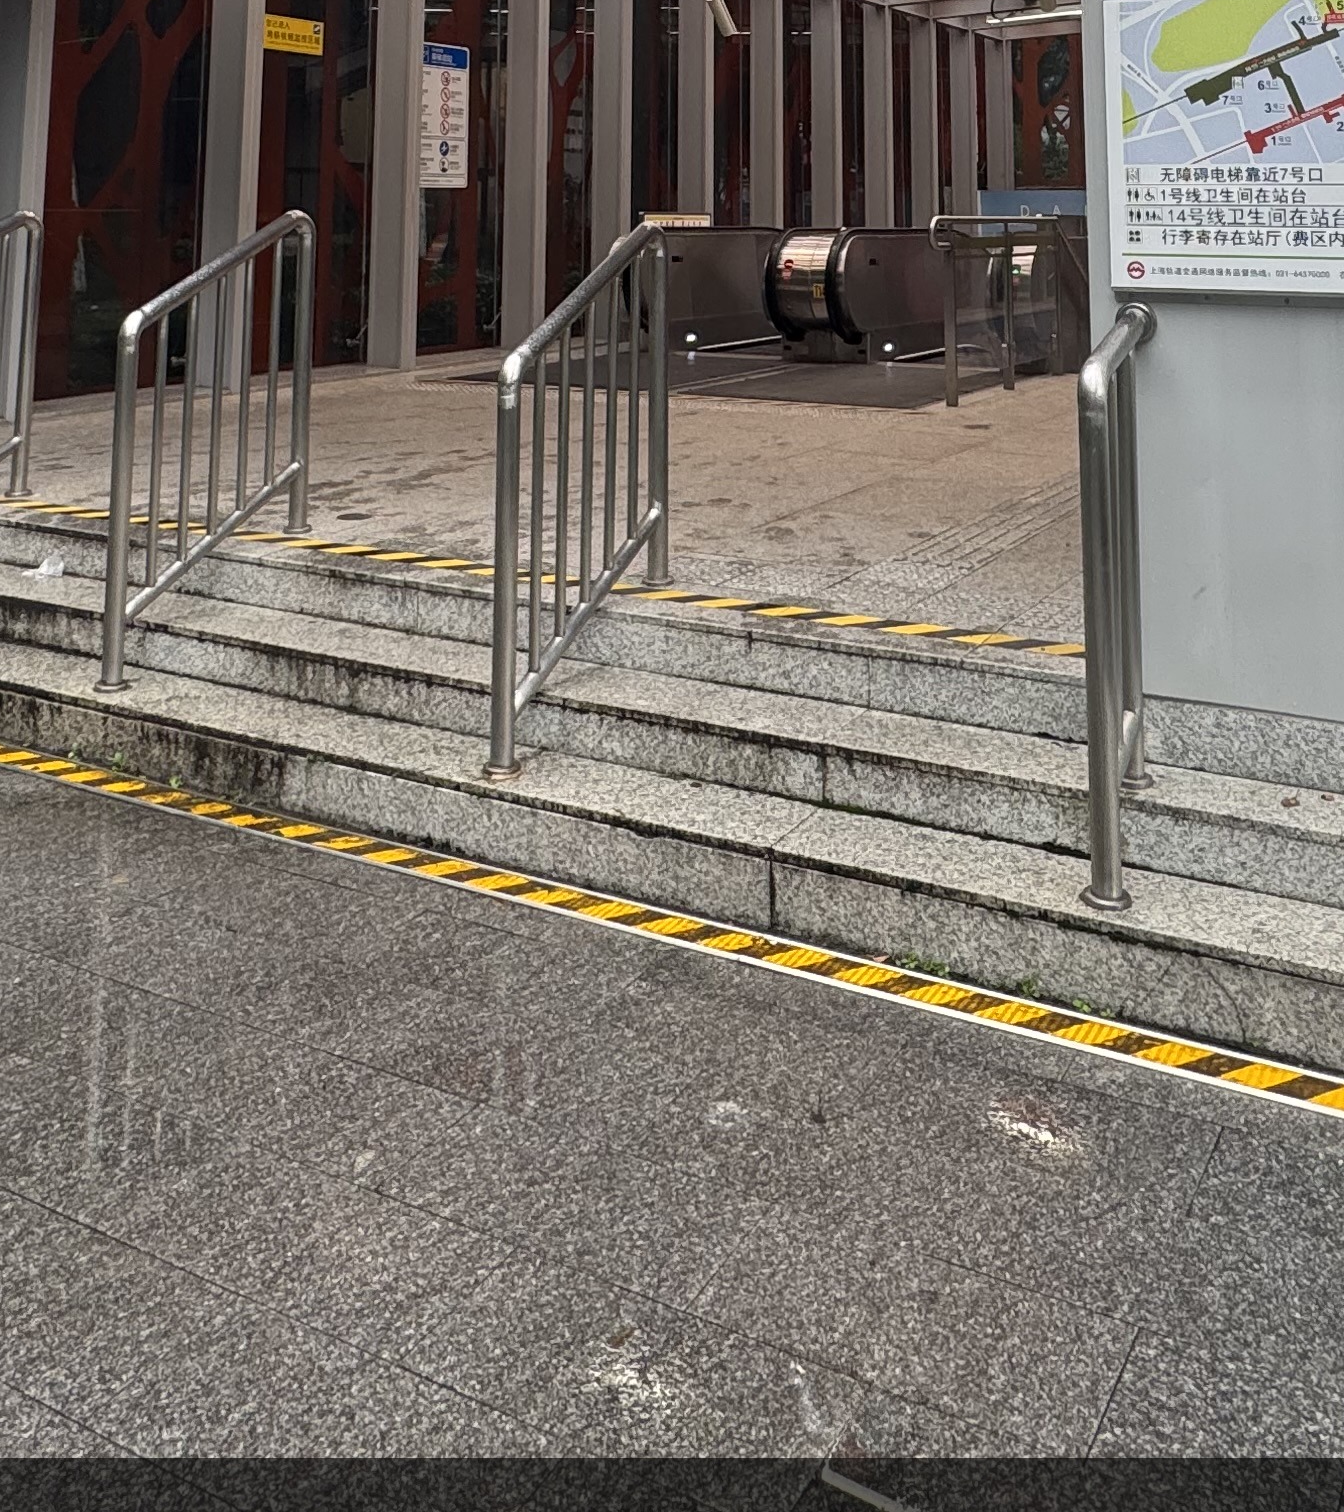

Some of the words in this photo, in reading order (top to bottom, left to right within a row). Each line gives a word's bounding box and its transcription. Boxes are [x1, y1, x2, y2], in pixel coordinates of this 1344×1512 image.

[1159, 166, 1323, 183] 无障碍电梯靠近7号口
[1160, 187, 1307, 204] 1号线卫生间在站台
